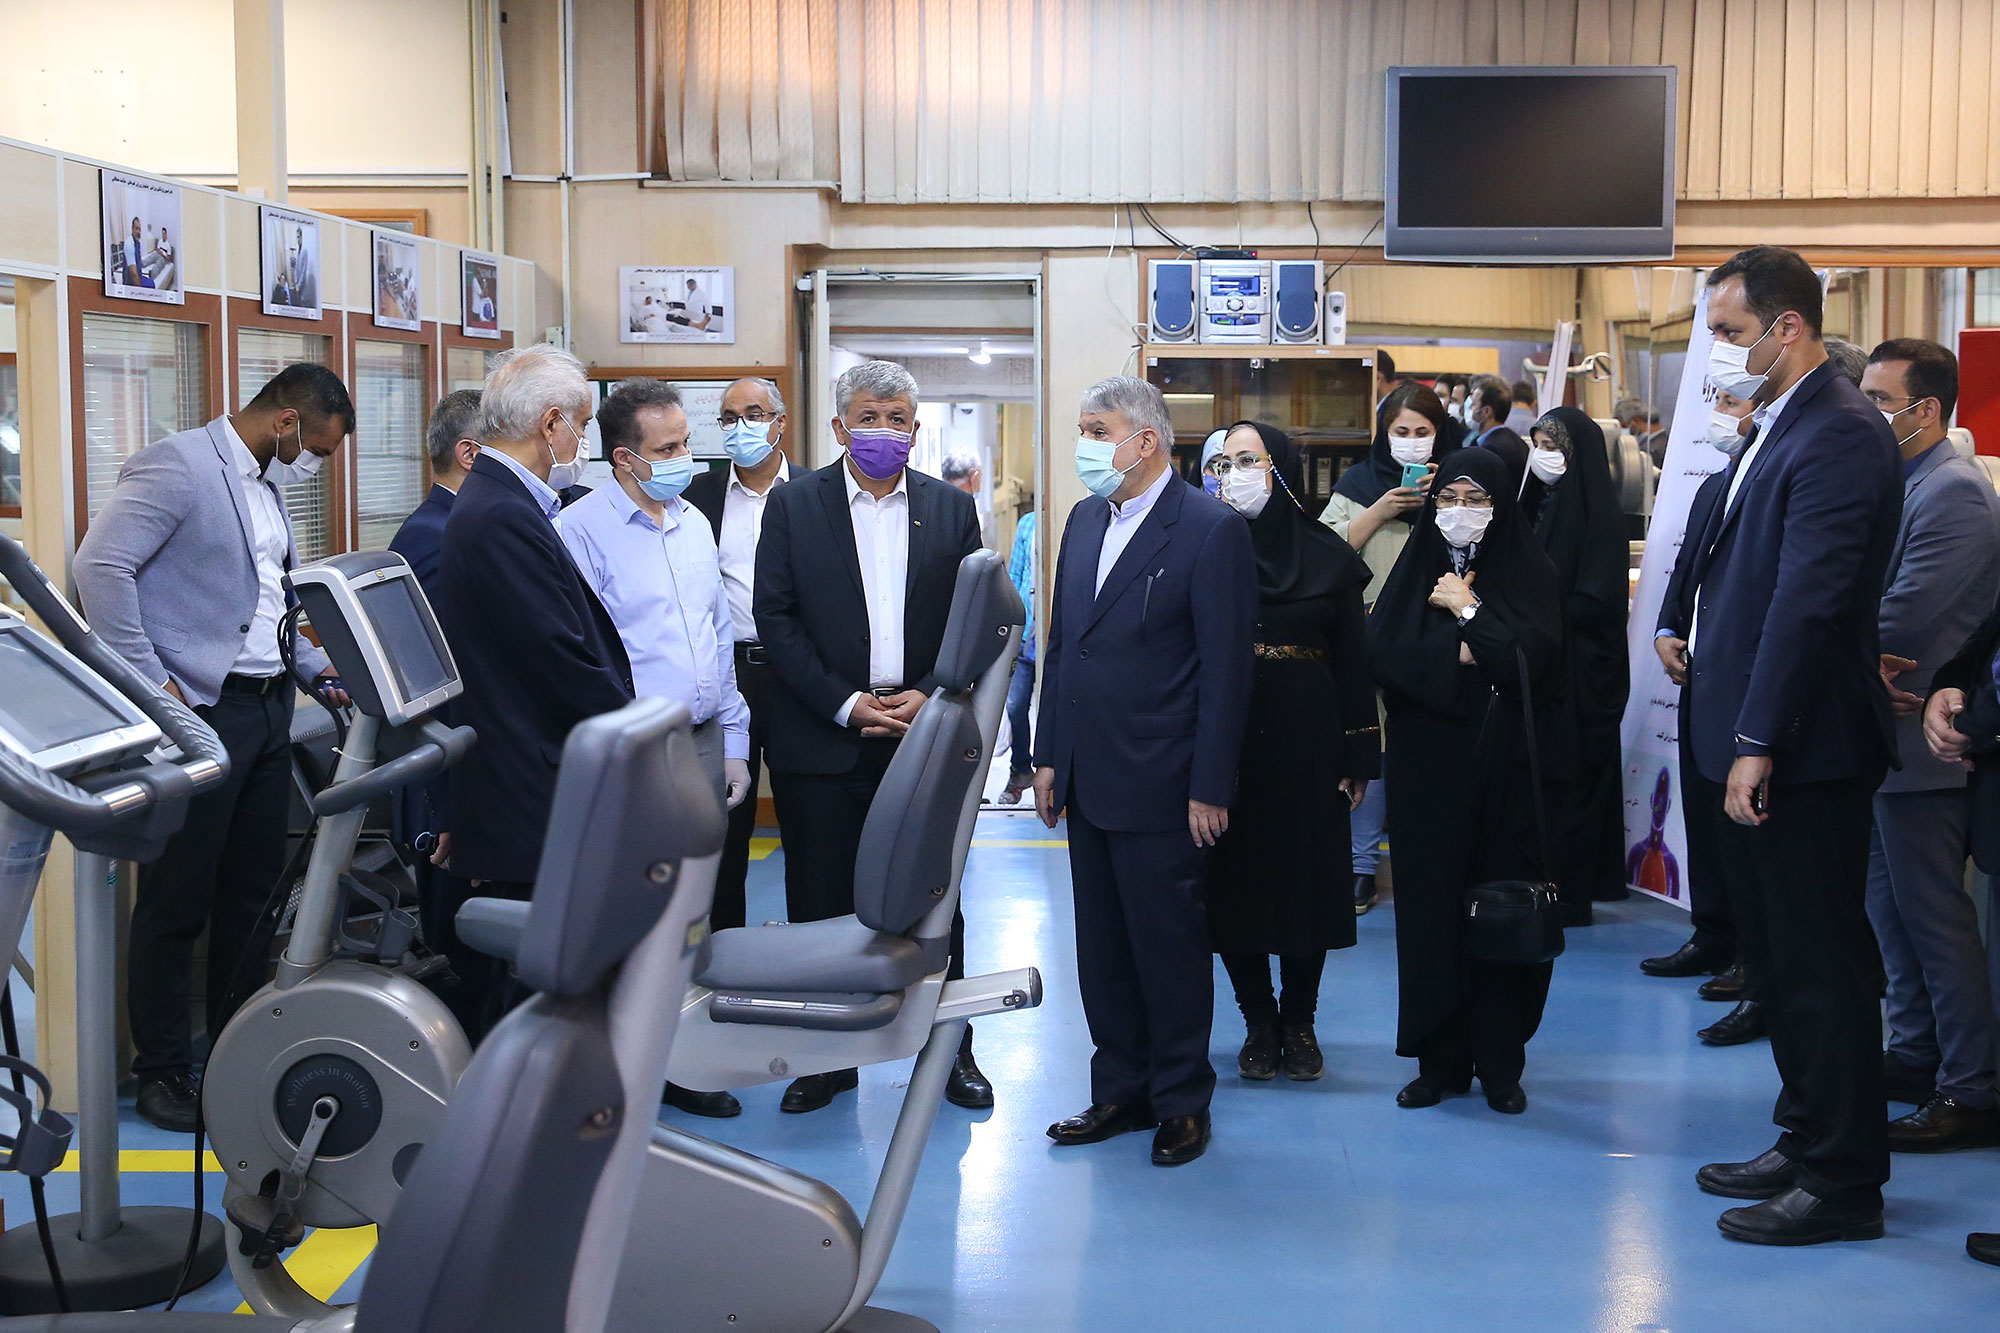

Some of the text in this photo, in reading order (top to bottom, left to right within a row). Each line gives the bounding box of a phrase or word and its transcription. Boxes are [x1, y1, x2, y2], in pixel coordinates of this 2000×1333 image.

[287, 1065, 369, 1108] Wellness in motion
